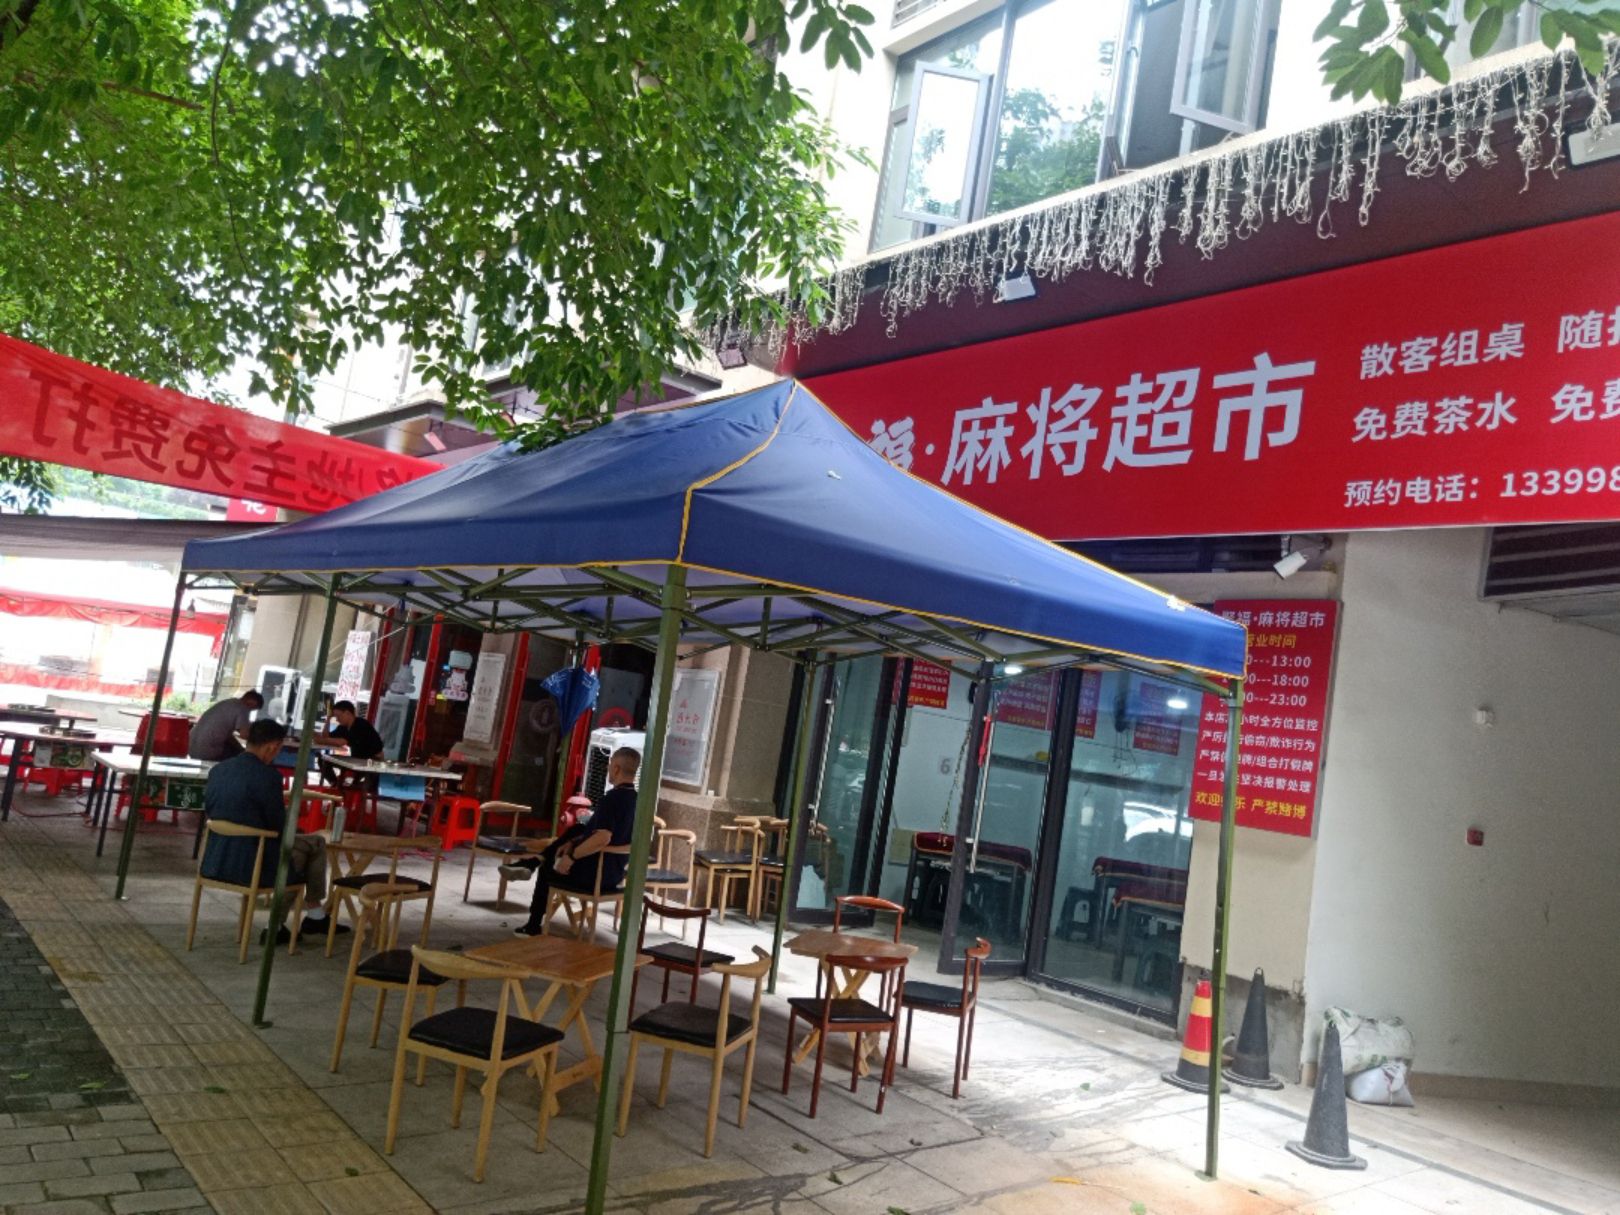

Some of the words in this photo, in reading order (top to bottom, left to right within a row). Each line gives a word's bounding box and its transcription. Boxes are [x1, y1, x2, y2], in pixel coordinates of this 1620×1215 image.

[1360, 322, 1525, 380] 散客组桌
[1351, 391, 1518, 443] 免费茶水
